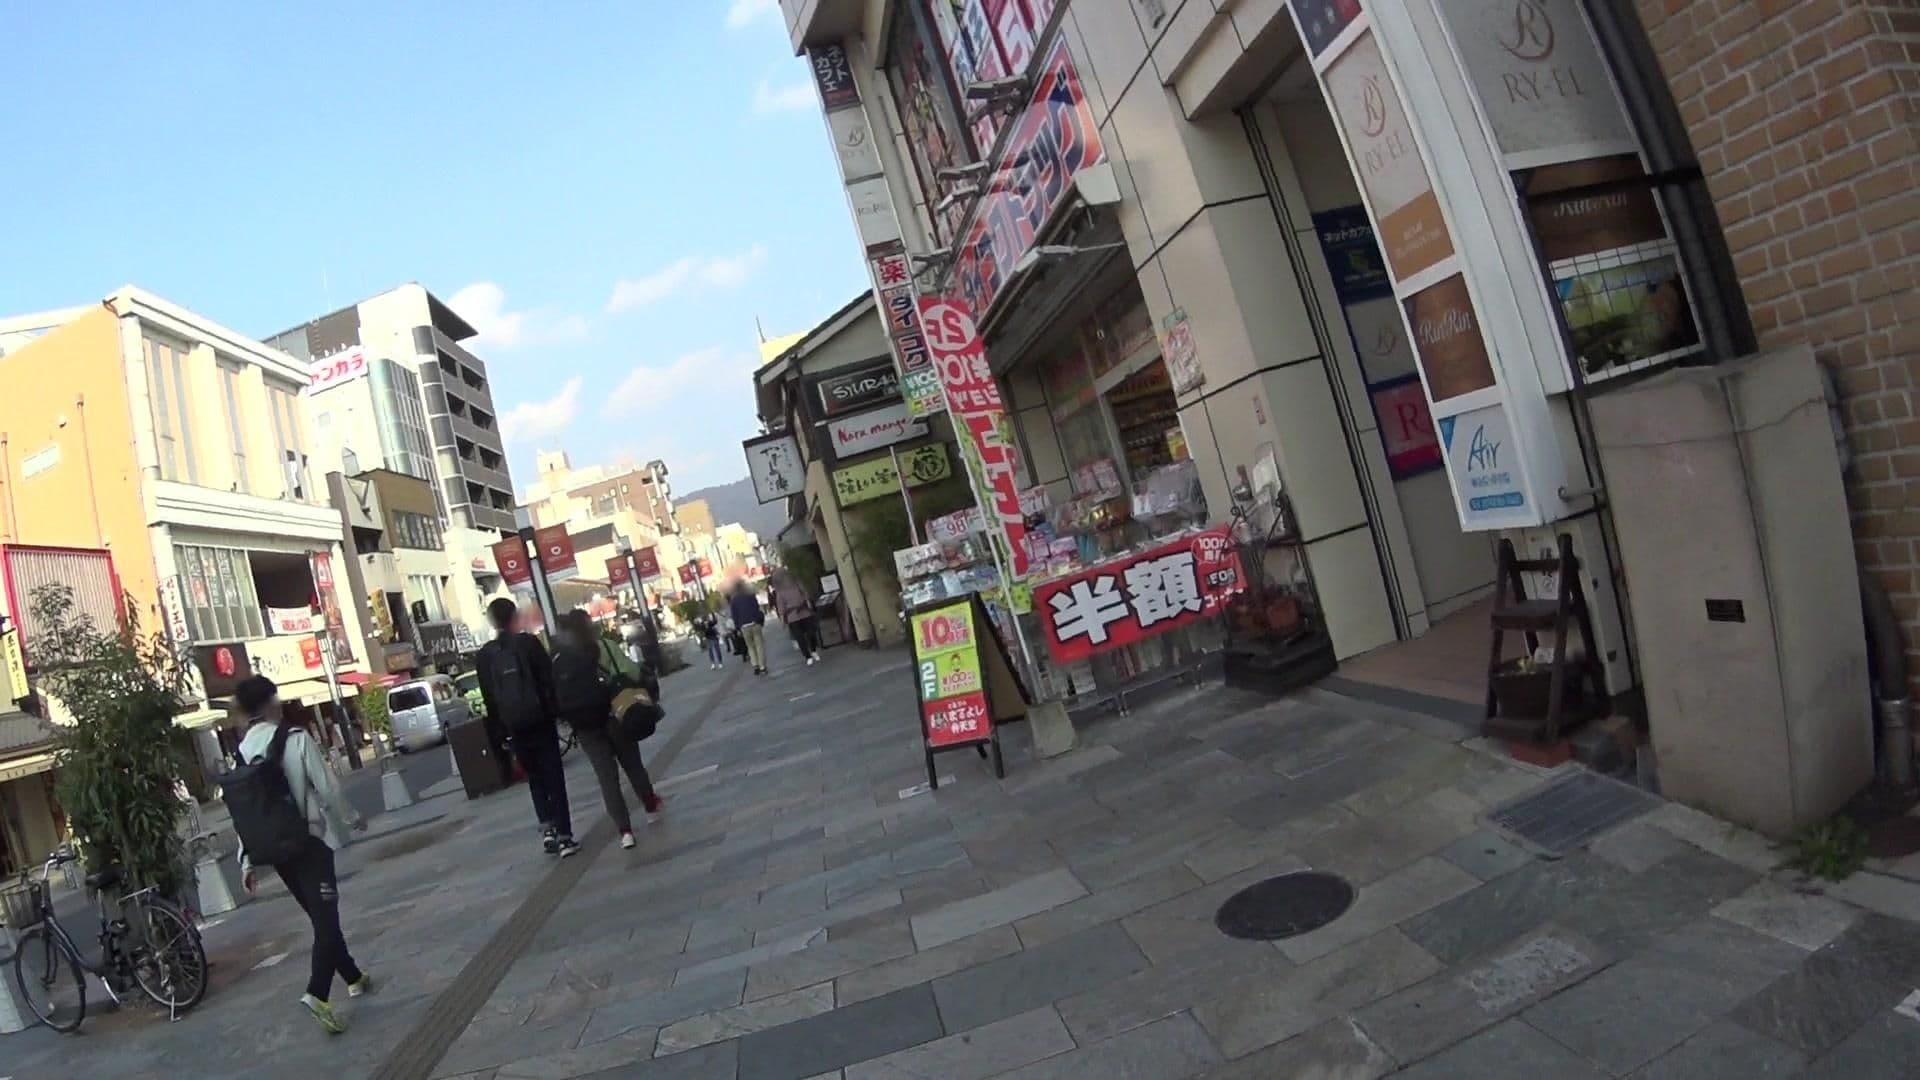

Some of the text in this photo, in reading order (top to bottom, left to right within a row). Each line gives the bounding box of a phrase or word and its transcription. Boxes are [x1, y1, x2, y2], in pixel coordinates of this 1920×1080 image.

[815, 56, 839, 92] カフェ
[828, 45, 849, 82] ネット
[879, 258, 907, 284] 薬
[1467, 423, 1502, 473] Air
[1048, 551, 1204, 646] 半額
[920, 660, 938, 699] 2F
